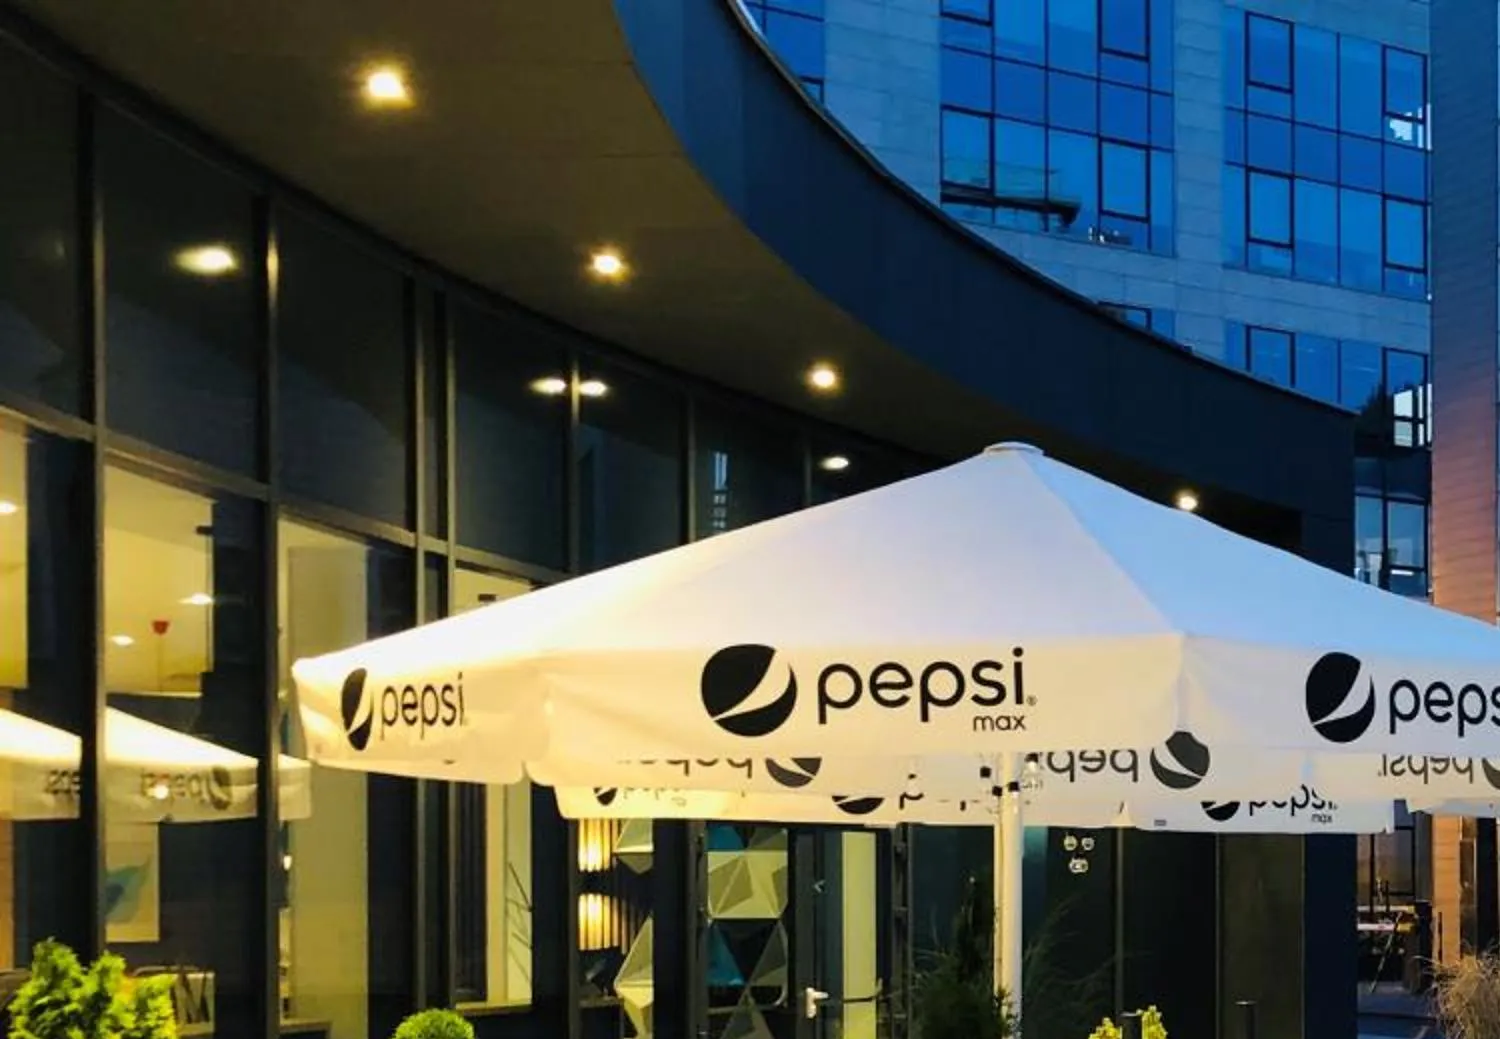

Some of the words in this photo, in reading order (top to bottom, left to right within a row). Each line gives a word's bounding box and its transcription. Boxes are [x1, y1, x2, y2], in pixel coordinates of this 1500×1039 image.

[381, 672, 464, 741] pepsi
[818, 647, 1024, 725] pepsi
[973, 715, 1026, 731] max
